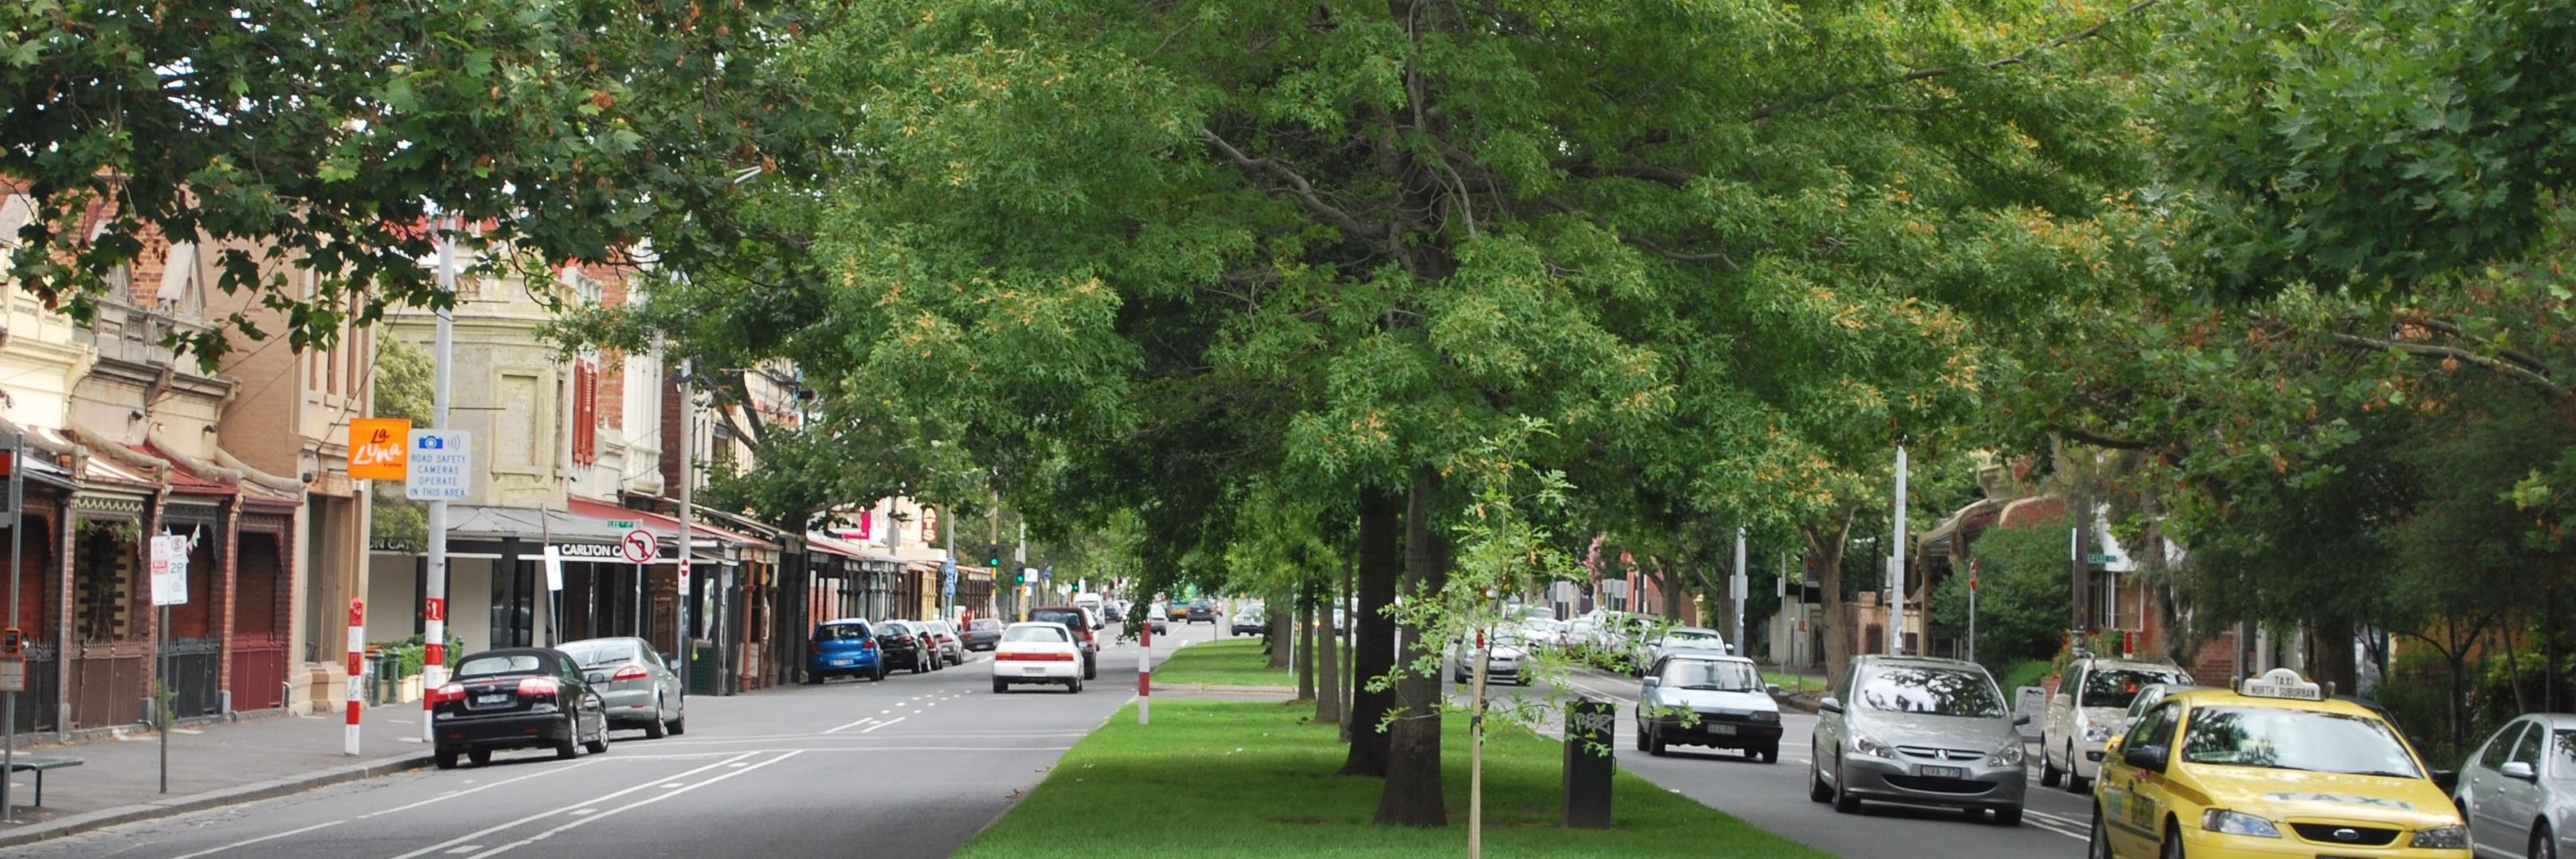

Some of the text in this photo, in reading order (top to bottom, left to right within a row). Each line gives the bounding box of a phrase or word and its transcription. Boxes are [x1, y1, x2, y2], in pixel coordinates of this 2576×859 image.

[411, 453, 466, 463] ROAD SAFETY
[418, 477, 458, 485] OPERATE
[410, 488, 418, 496] IN
[922, 507, 937, 541] ATS
[562, 543, 611, 555] CARLTON
[170, 563, 184, 573] 2P
[2275, 676, 2294, 685] TAXI
[2251, 685, 2316, 697] NORTH SUBURBAN
[2265, 792, 2412, 810] TAXI
